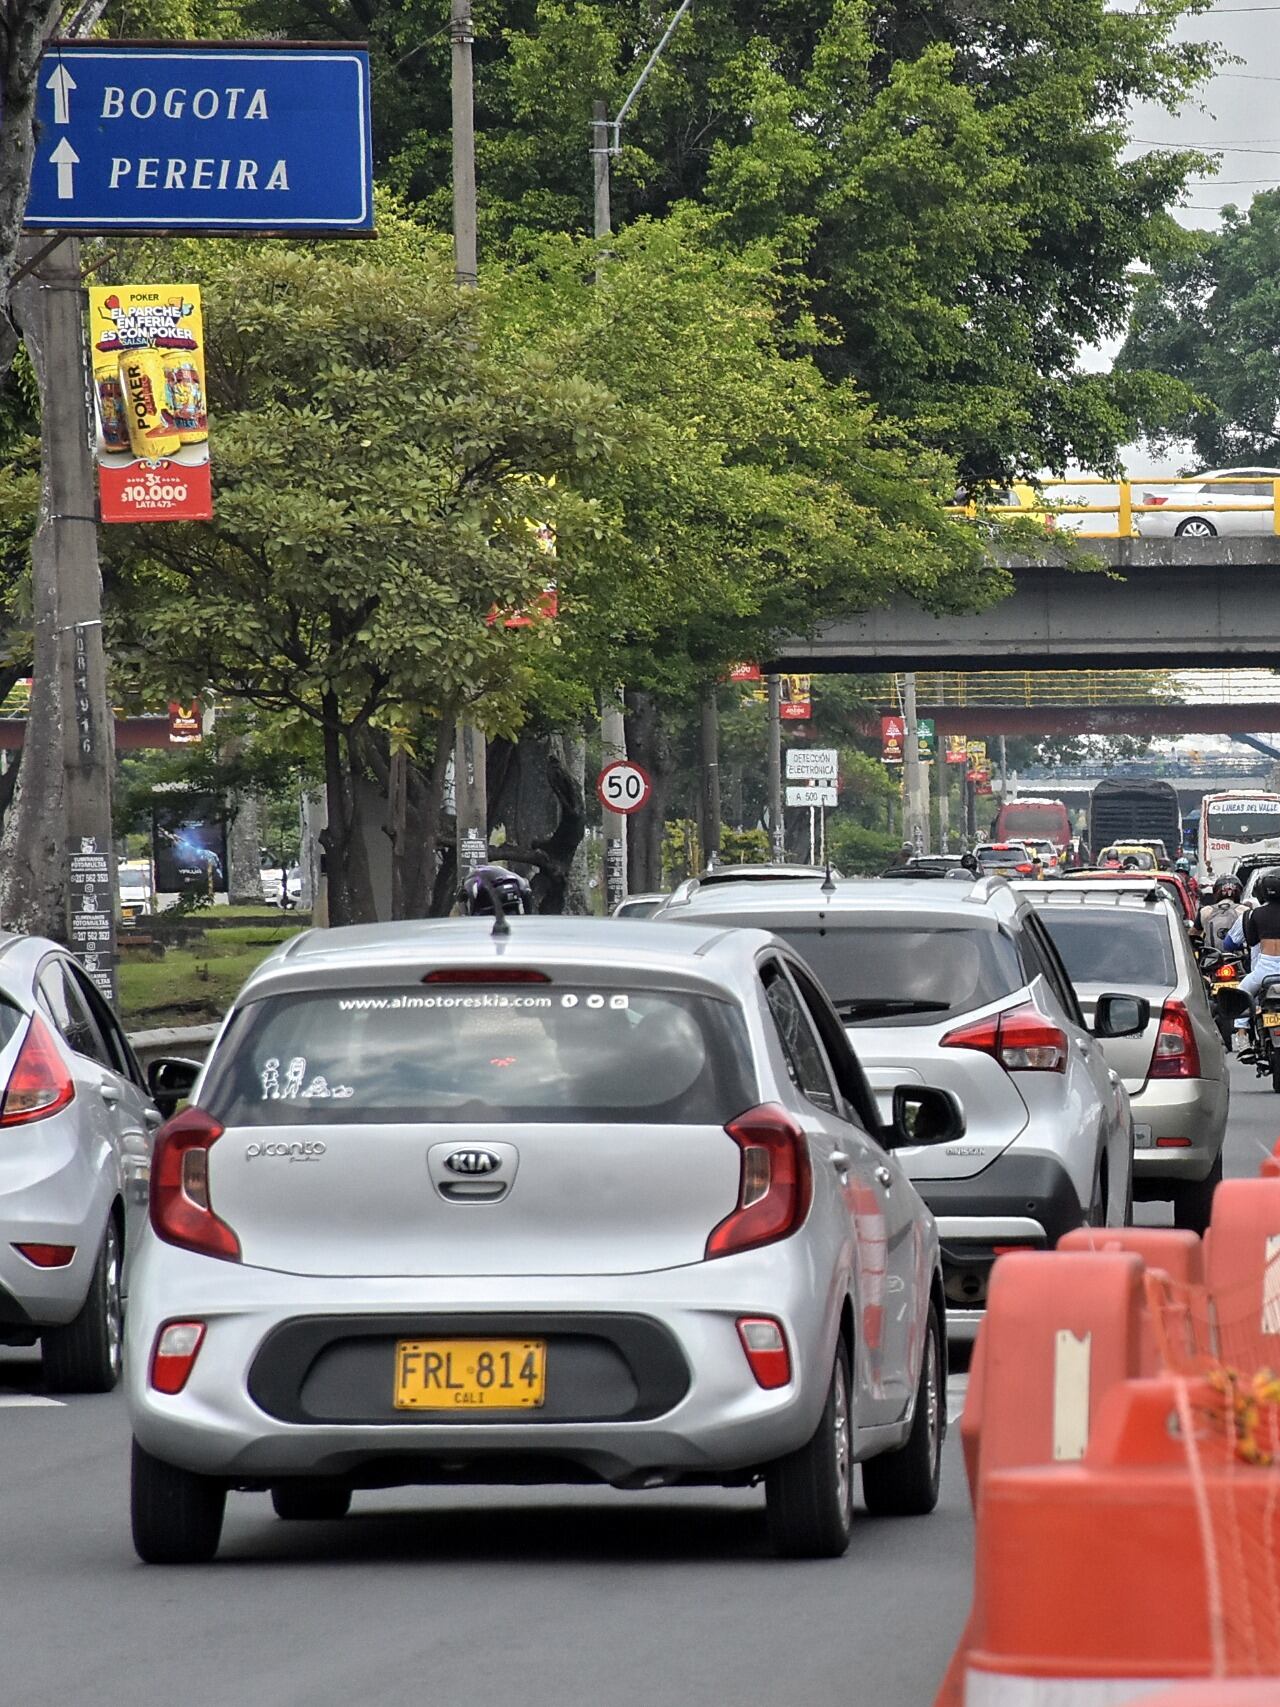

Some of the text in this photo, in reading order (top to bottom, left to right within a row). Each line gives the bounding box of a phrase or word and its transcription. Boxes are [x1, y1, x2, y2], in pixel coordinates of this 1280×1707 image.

[100, 86, 269, 120] BOGOTA
[107, 157, 291, 191] PEREIRA
[130, 293, 159, 302] POKER
[111, 306, 181, 319] EL PARCHE
[117, 316, 176, 329] EN FERIA
[101, 327, 193, 341] ES CON POKER
[127, 364, 151, 430] POKER
[136, 501, 156, 509] LATA
[608, 774, 641, 799] 50
[339, 994, 552, 1011] www.almotoreskia.com
[245, 1141, 327, 1163] picanto
[451, 1153, 492, 1172] KIA
[453, 1391, 485, 1404] CALI
